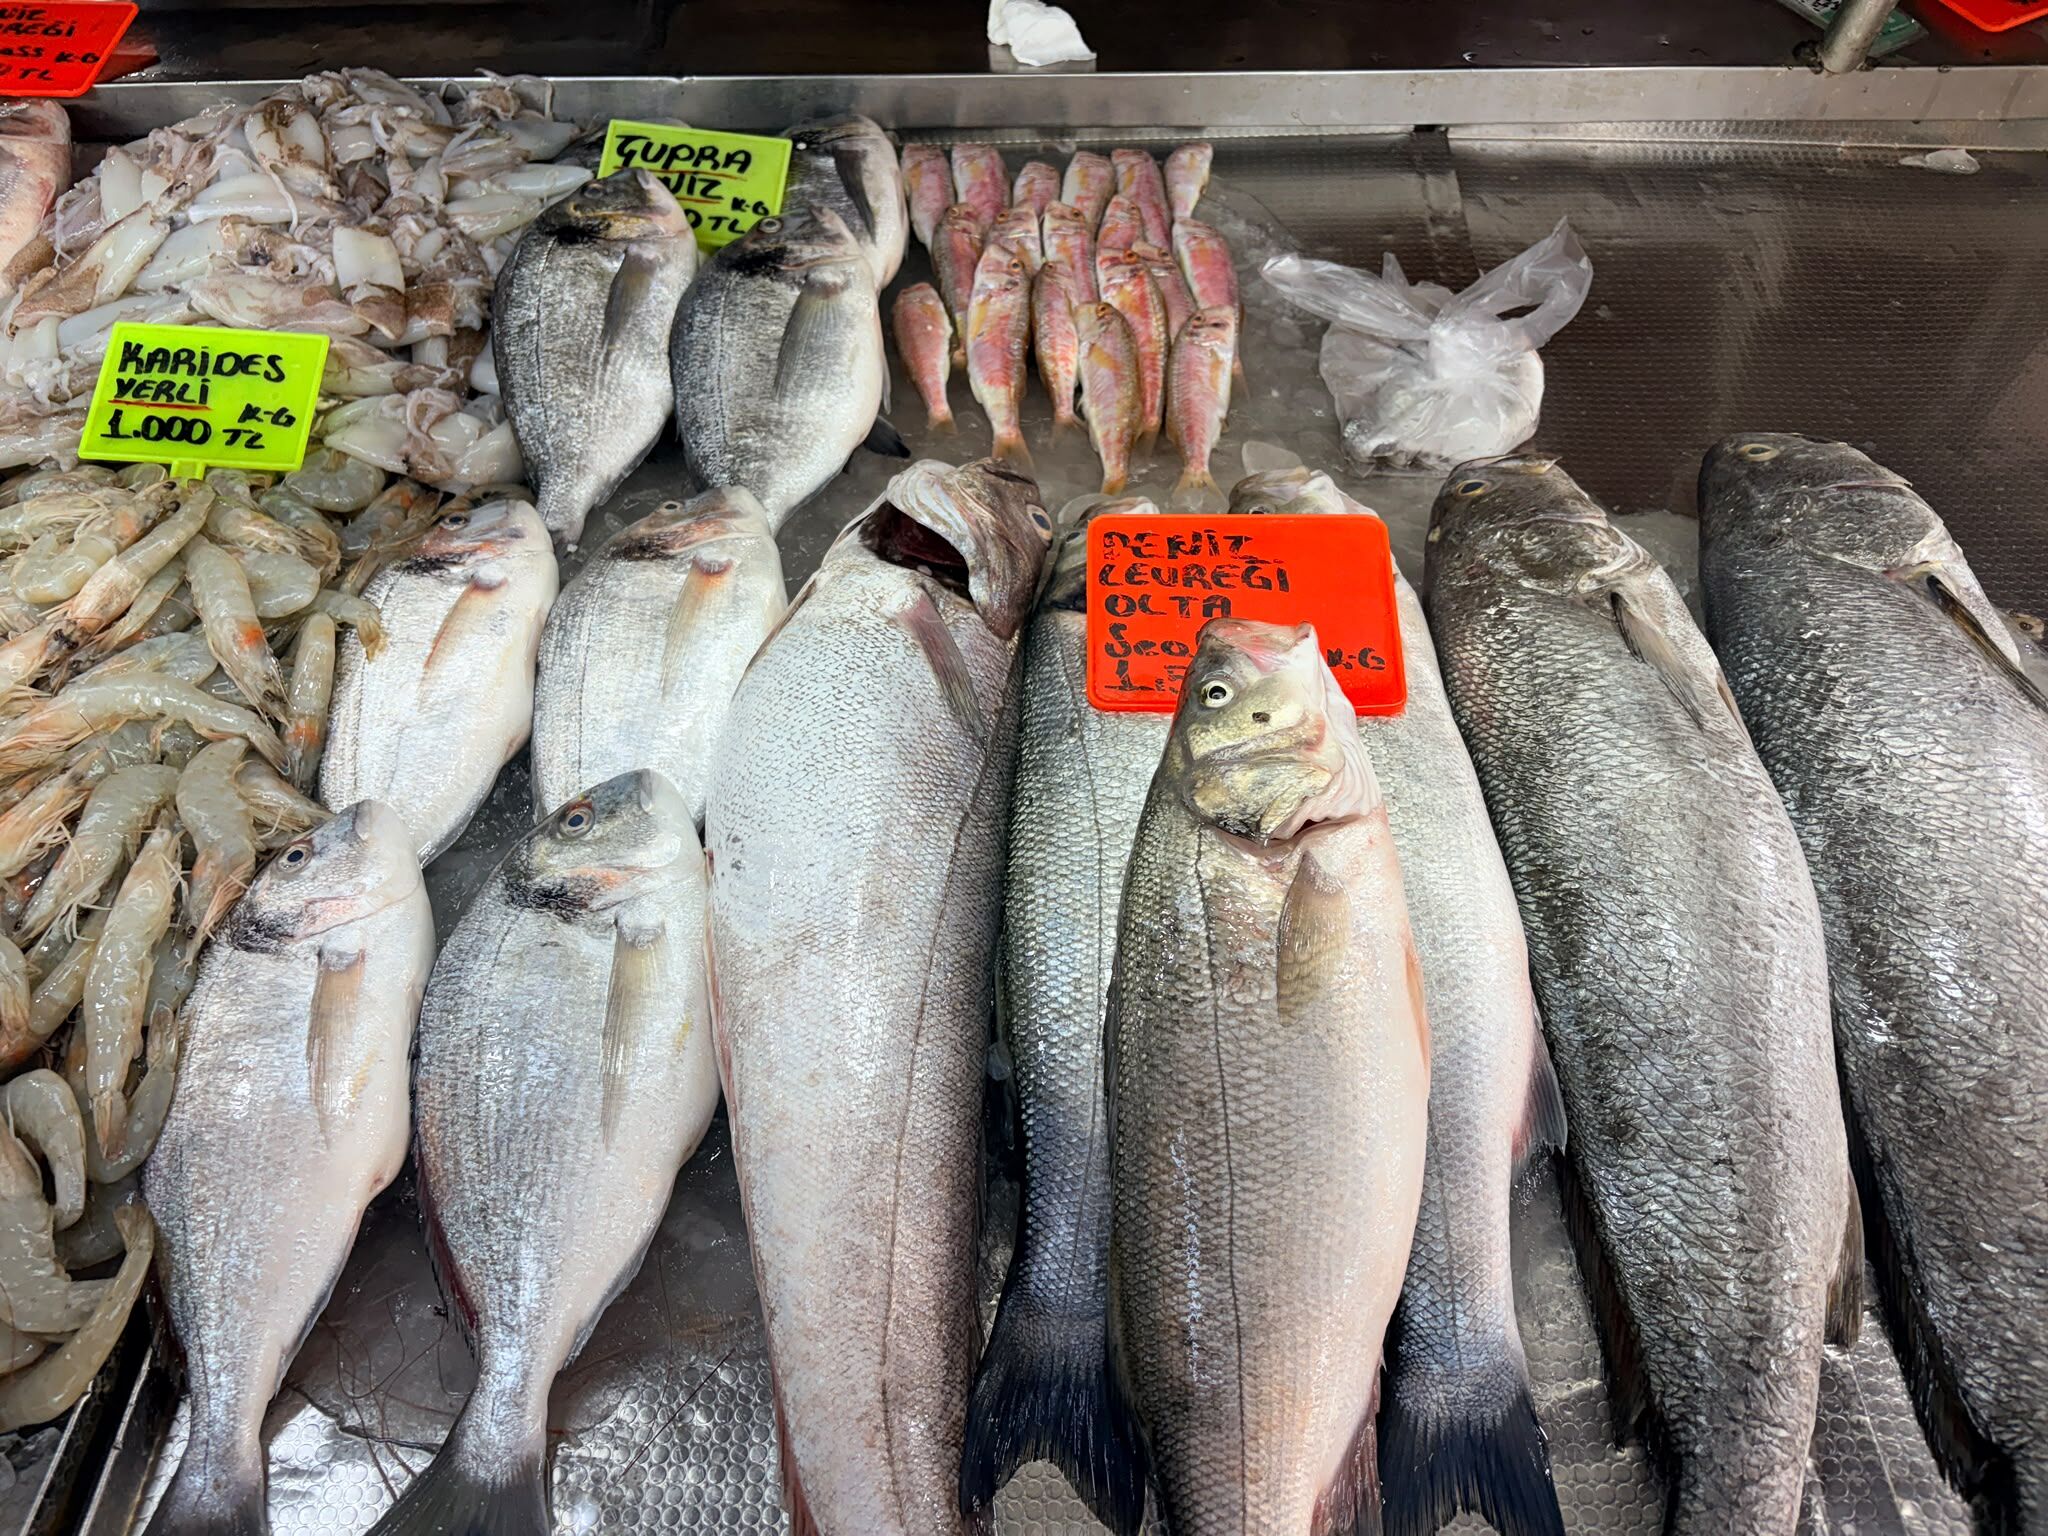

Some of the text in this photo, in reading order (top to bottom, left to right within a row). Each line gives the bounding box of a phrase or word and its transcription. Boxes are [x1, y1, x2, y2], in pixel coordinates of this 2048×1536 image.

[708, 216, 746, 234] TL
[118, 340, 286, 383] KARİDES
[114, 377, 211, 405] YERLİ
[100, 409, 265, 450] 1.000 TL
